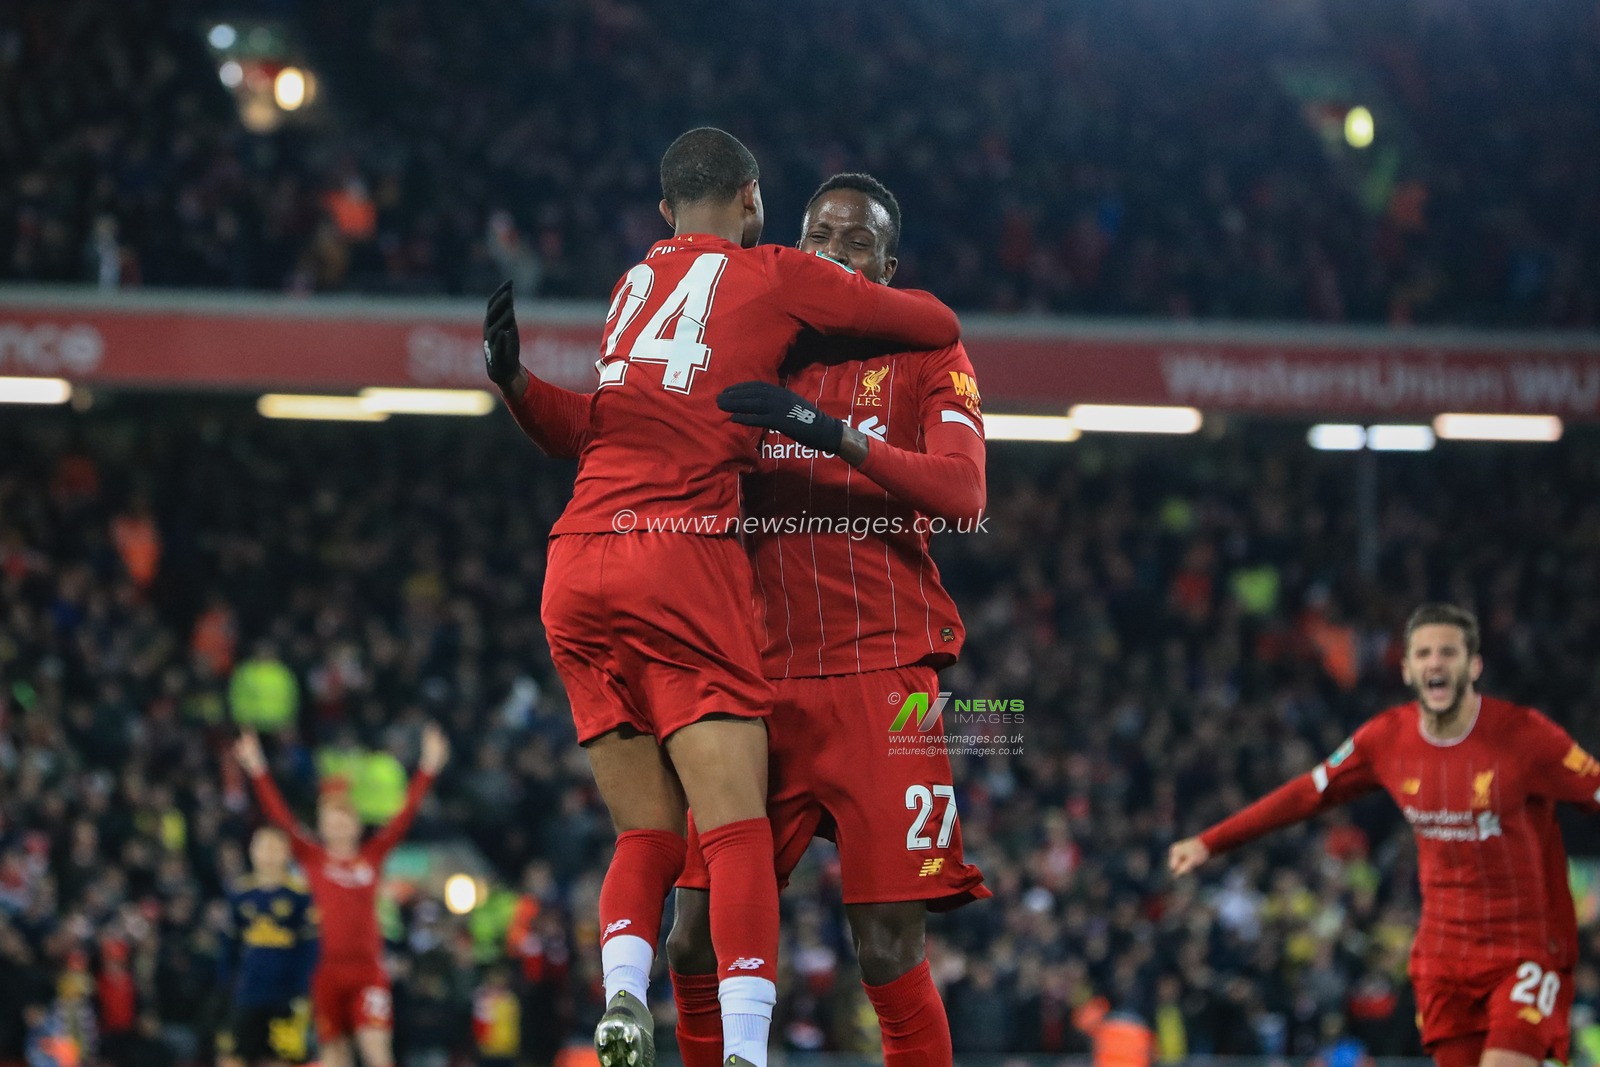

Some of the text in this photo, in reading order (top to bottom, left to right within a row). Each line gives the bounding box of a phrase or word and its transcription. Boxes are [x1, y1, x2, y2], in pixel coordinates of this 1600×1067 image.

[595, 253, 728, 395] 24
[905, 784, 957, 850] 27
[1510, 961, 1560, 1017] 20
